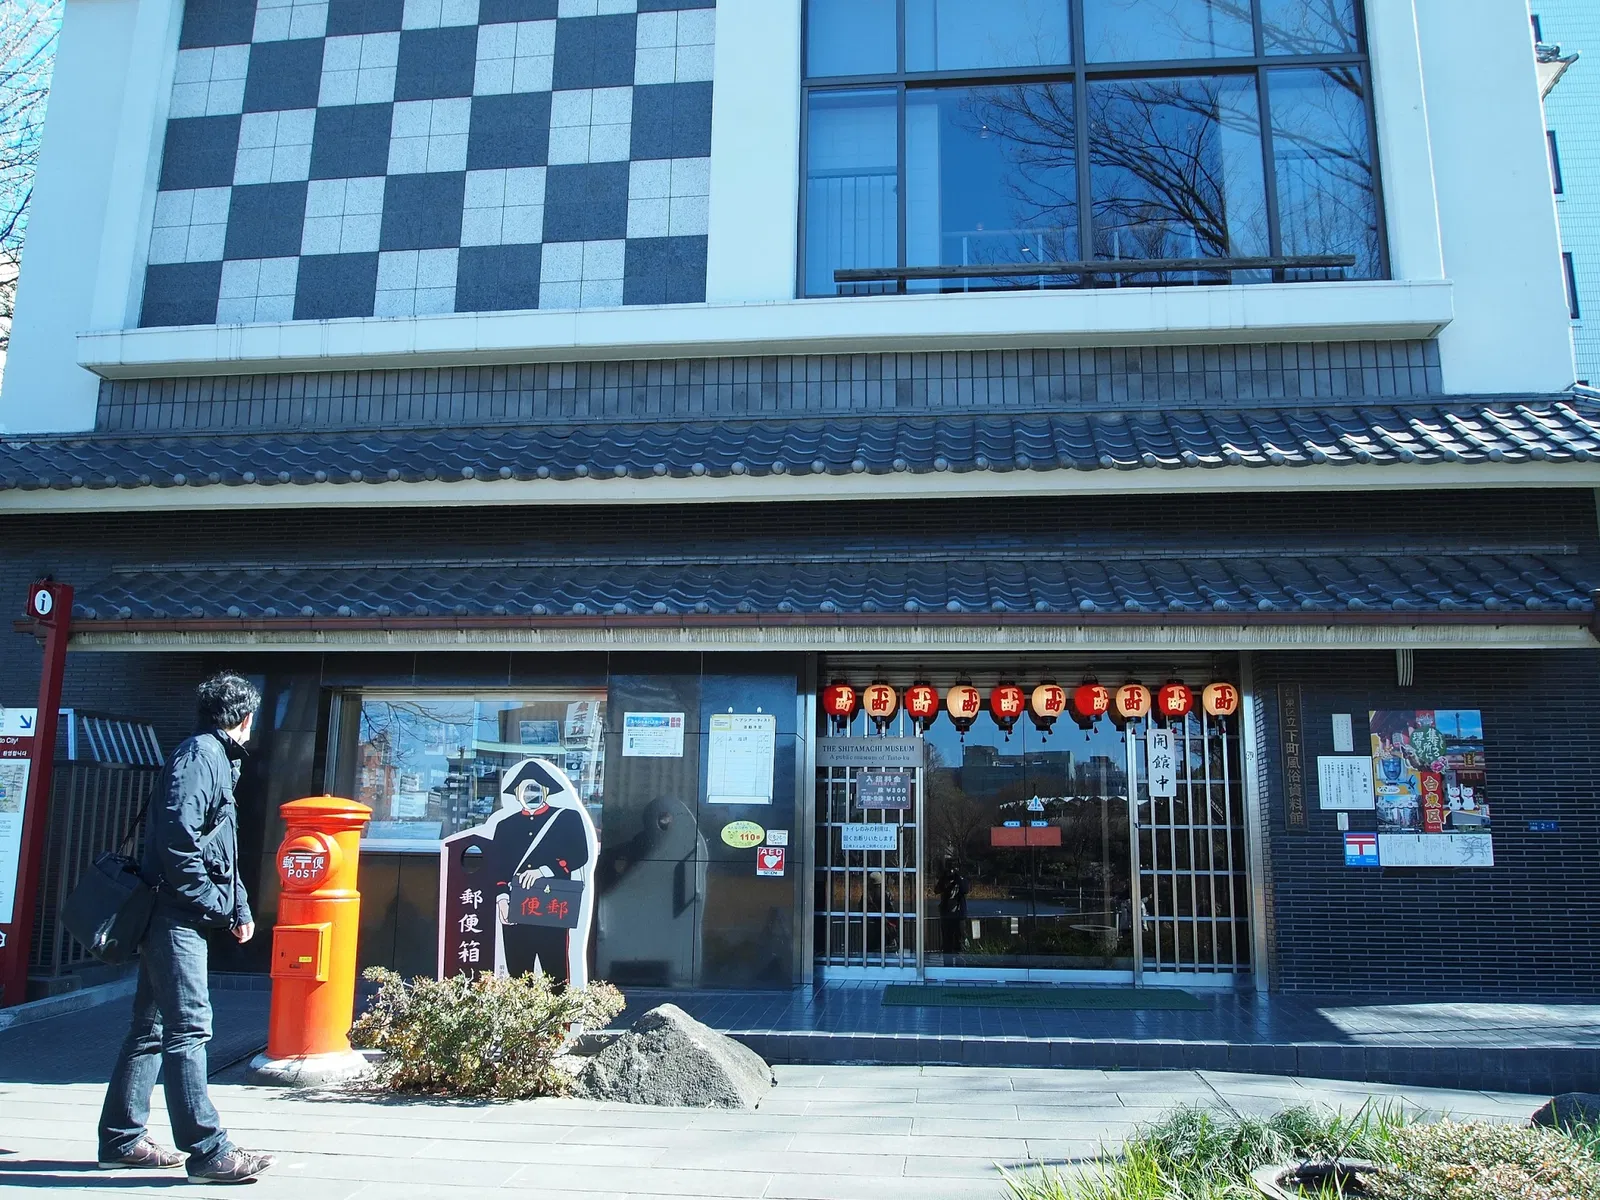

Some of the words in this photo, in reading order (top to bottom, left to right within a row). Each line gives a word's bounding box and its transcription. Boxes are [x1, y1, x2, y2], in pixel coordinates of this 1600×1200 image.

[1152, 733, 1171, 792] 開館中
[1423, 776, 1442, 824] 台東区
[287, 870, 318, 878] POST
[458, 888, 484, 963] 郵便箱
